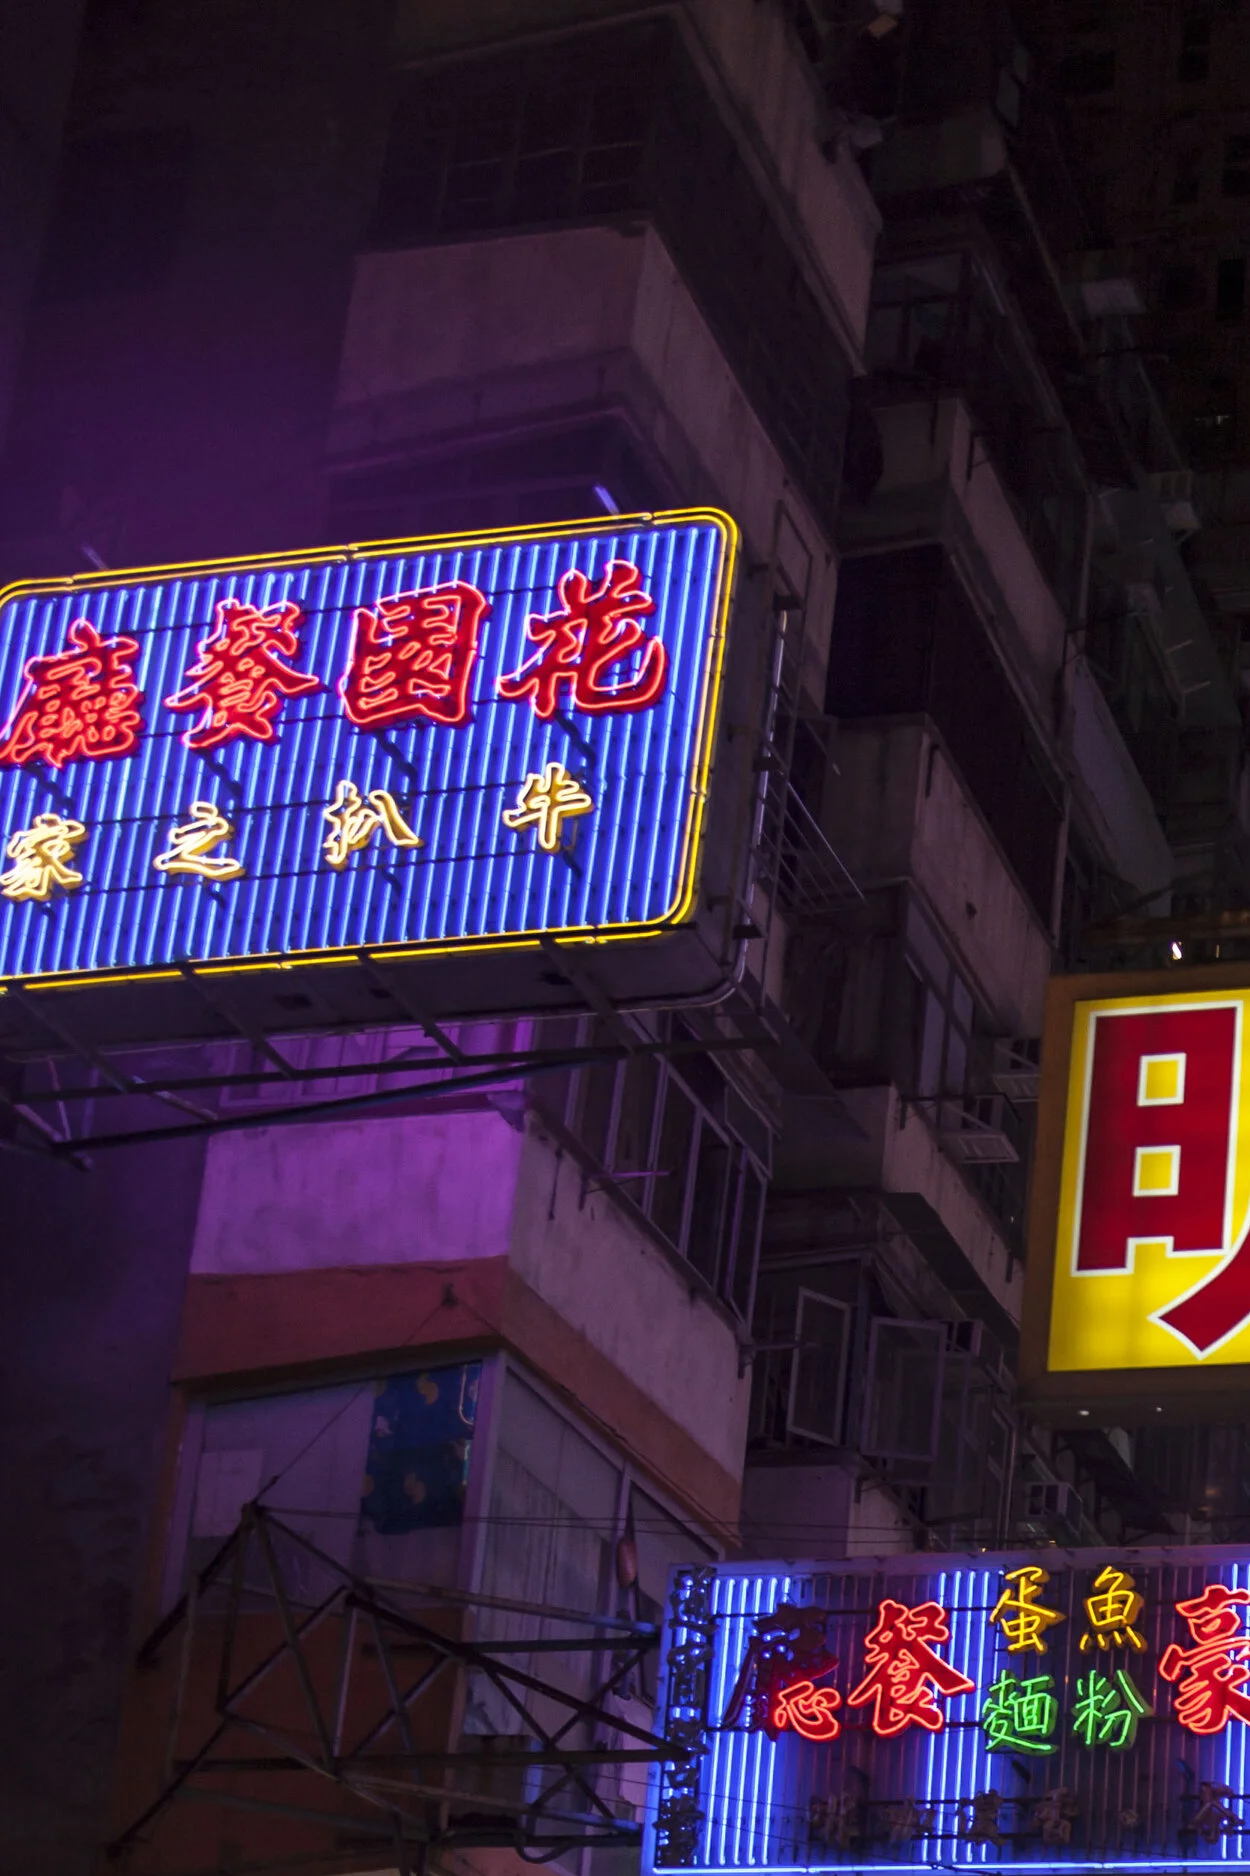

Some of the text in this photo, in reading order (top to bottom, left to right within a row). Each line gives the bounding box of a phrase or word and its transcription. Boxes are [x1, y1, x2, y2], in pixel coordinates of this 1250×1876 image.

[0, 558, 669, 768] 花園餐廳
[0, 762, 593, 899] 牛扒之家
[989, 1566, 1147, 1655] 魚蛋
[981, 1669, 1153, 1756] 粉麵
